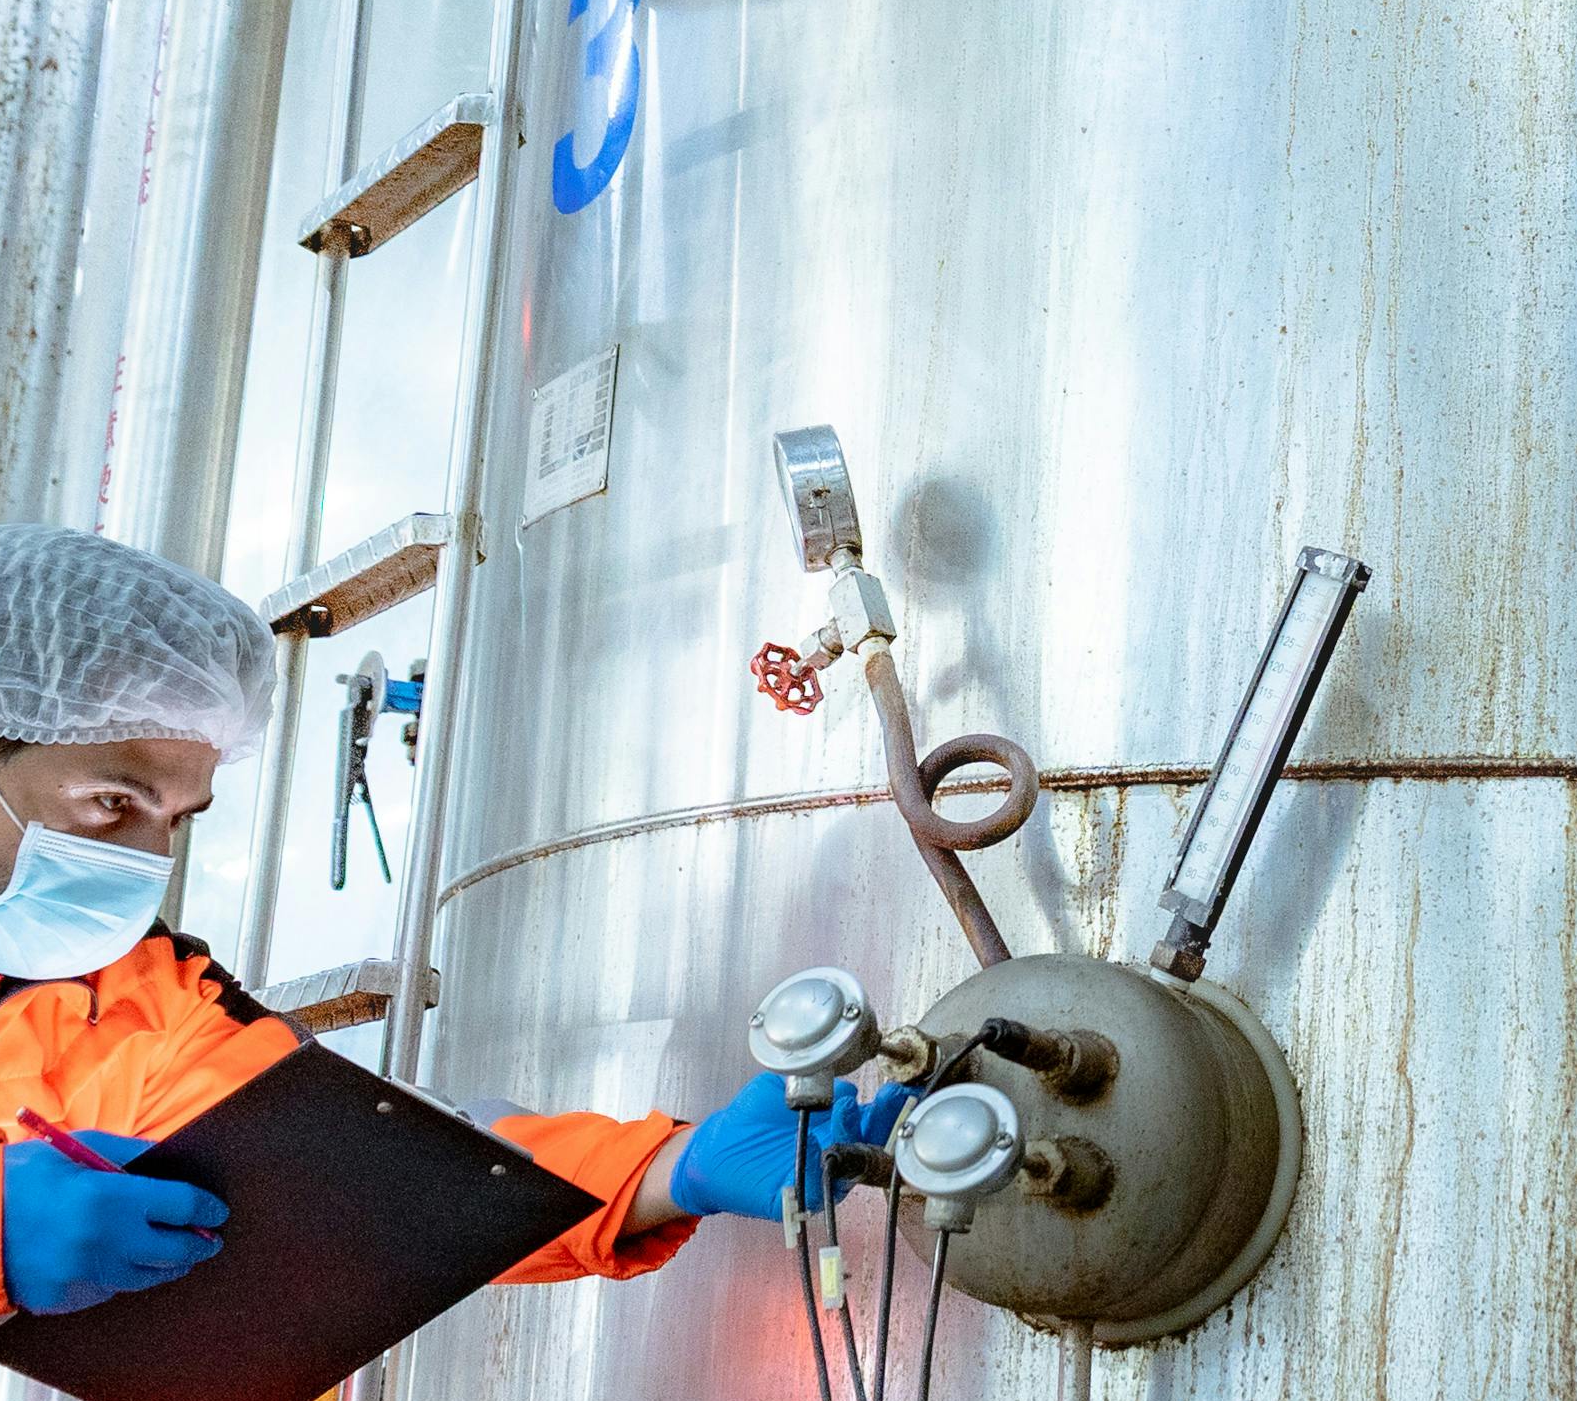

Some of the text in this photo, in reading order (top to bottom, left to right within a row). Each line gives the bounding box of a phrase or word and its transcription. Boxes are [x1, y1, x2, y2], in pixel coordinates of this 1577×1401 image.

[1279, 634, 1295, 648] 125
[1268, 660, 1284, 674] 120
[1258, 685, 1274, 699] 115
[1248, 711, 1263, 726] 110
[1236, 737, 1252, 751] 105
[1225, 762, 1241, 776] 100
[1219, 789, 1230, 802] 95
[1207, 815, 1219, 828] 90
